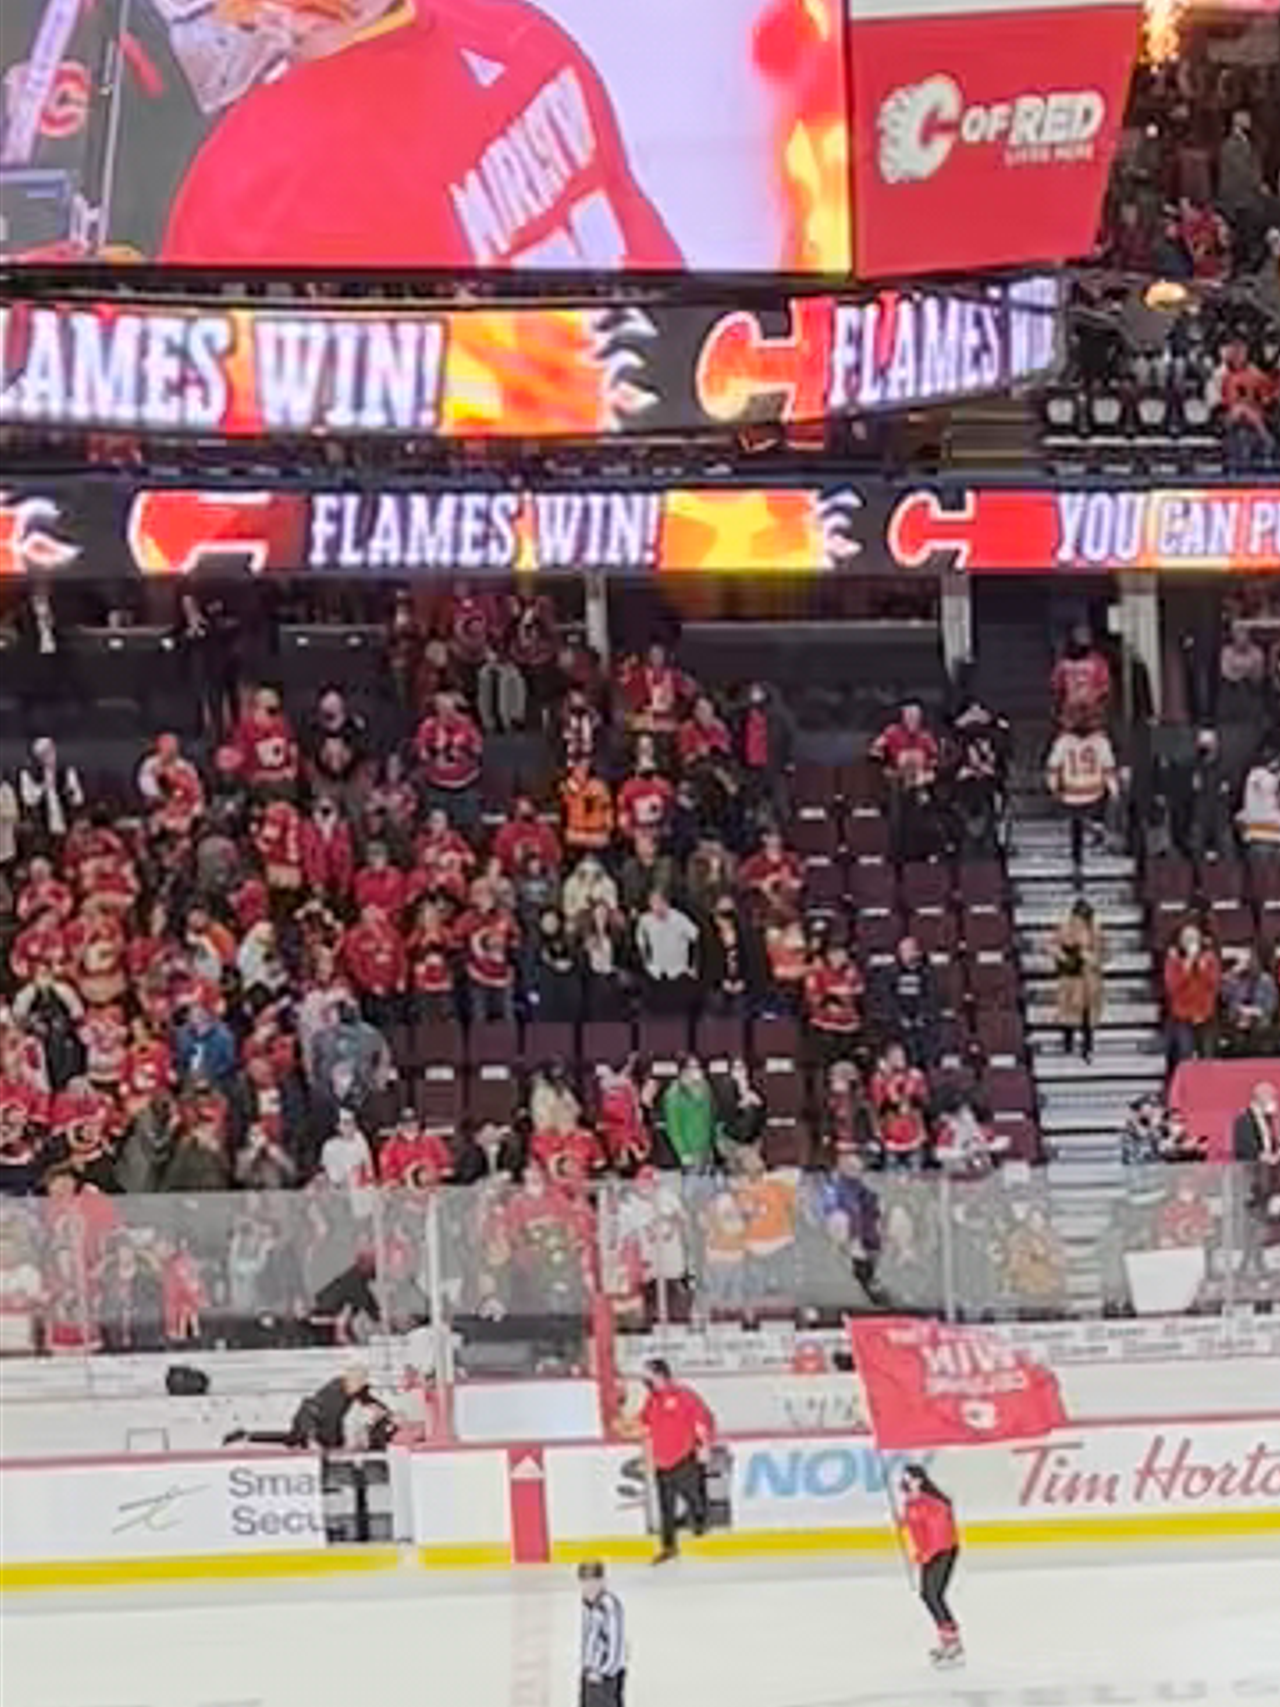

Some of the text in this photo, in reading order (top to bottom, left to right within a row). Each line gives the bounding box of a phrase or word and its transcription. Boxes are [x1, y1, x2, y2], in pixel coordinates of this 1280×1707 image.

[961, 103, 1010, 143] OF
[1008, 91, 1106, 146] RED
[254, 319, 444, 427] WIN!
[828, 296, 1000, 411] FLAMES
[309, 493, 660, 567] FLAMES WIN!
[1057, 493, 1150, 561] YOU
[1157, 498, 1238, 556] CAN
[229, 1465, 319, 1499] Sma
[1012, 1442, 1120, 1506] Tim
